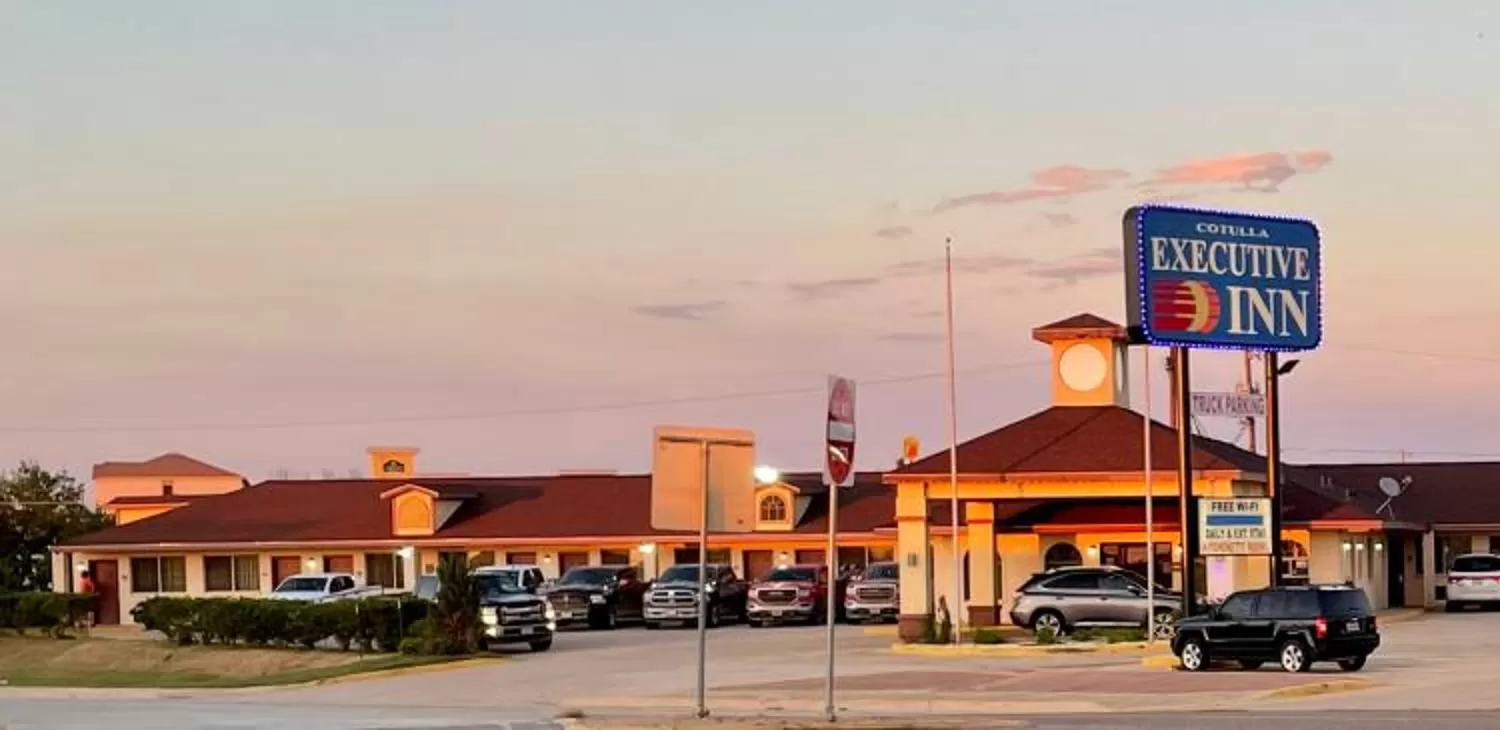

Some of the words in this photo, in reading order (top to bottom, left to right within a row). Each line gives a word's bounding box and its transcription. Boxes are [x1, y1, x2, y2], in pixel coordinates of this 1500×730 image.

[1196, 223, 1270, 238] COTULLA
[1151, 236, 1311, 281] EXECUTIVE
[1226, 285, 1310, 337] INN
[1193, 395, 1224, 413] TRUCK
[1225, 395, 1265, 415] PARKING
[1211, 501, 1234, 512] FREE
